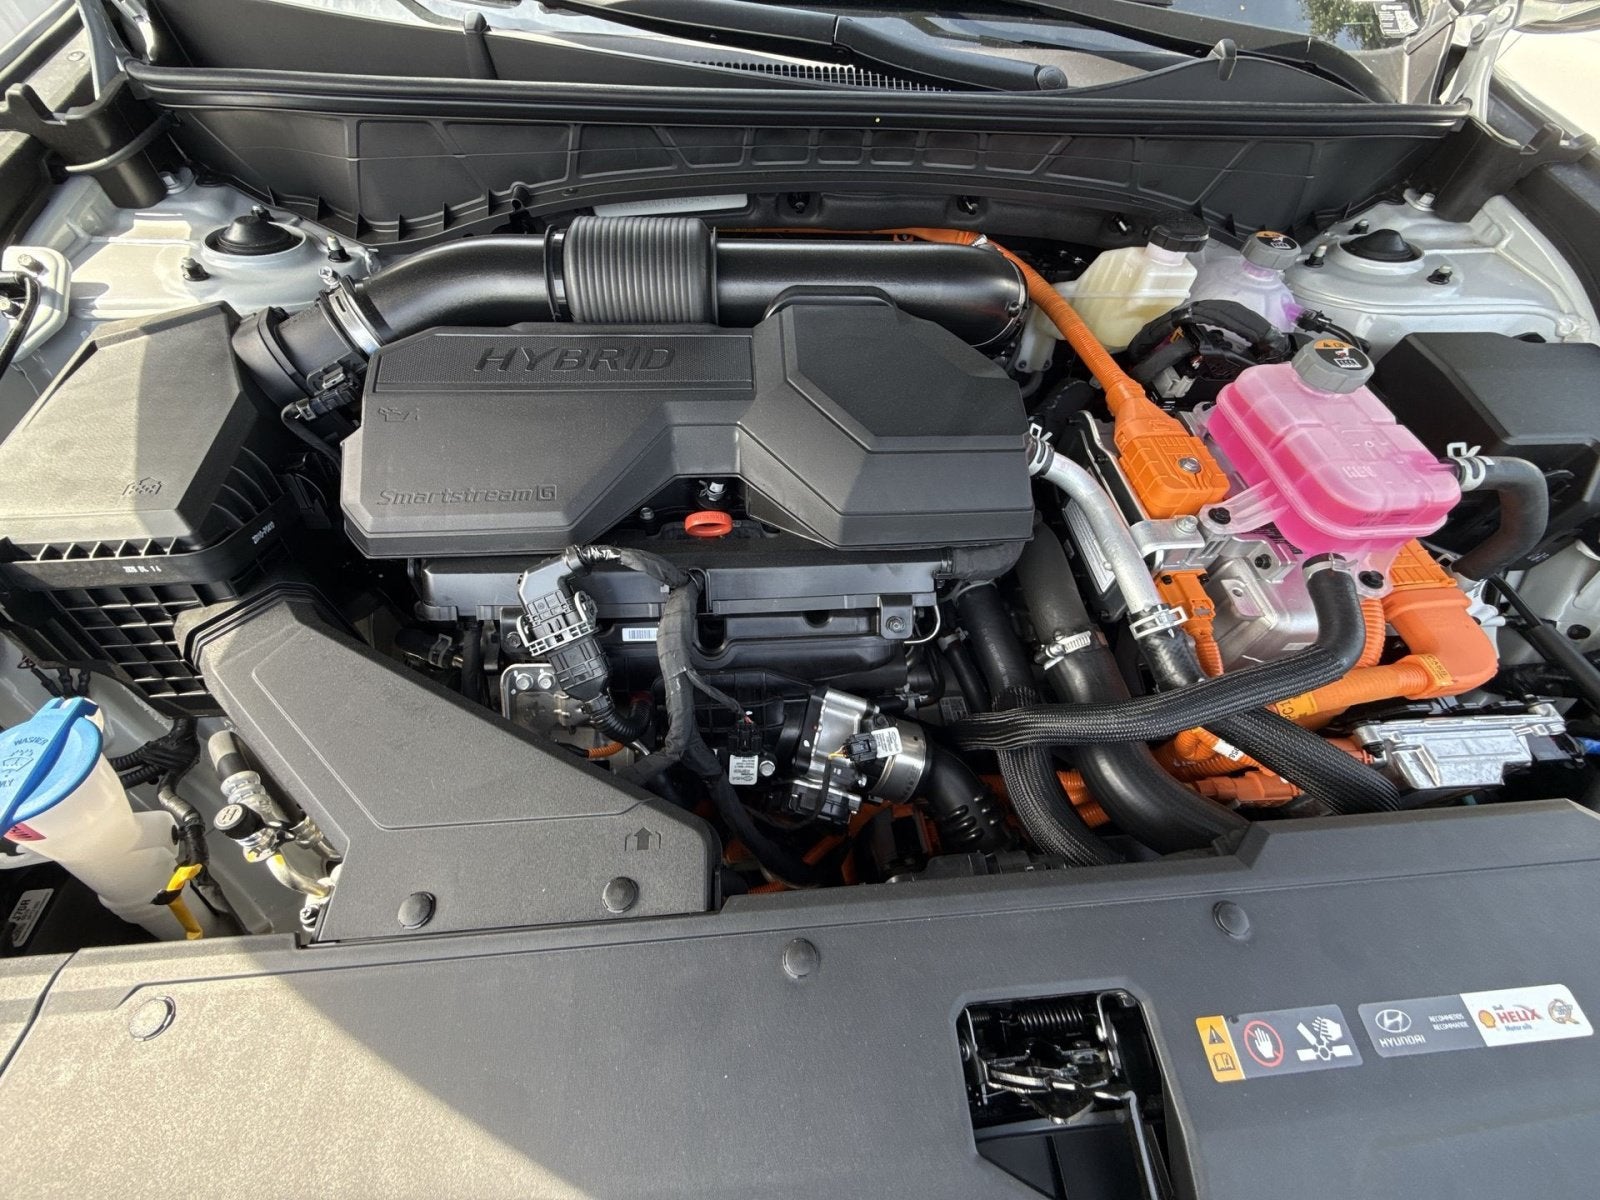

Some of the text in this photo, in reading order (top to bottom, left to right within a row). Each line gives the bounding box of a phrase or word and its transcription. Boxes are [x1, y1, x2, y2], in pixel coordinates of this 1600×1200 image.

[474, 347, 676, 372] HYBRID
[376, 485, 534, 505] Smartstream
[14, 736, 48, 746] WASHER
[1496, 1009, 1542, 1023] HELIX
[1379, 1033, 1426, 1048] HYUNDAI
